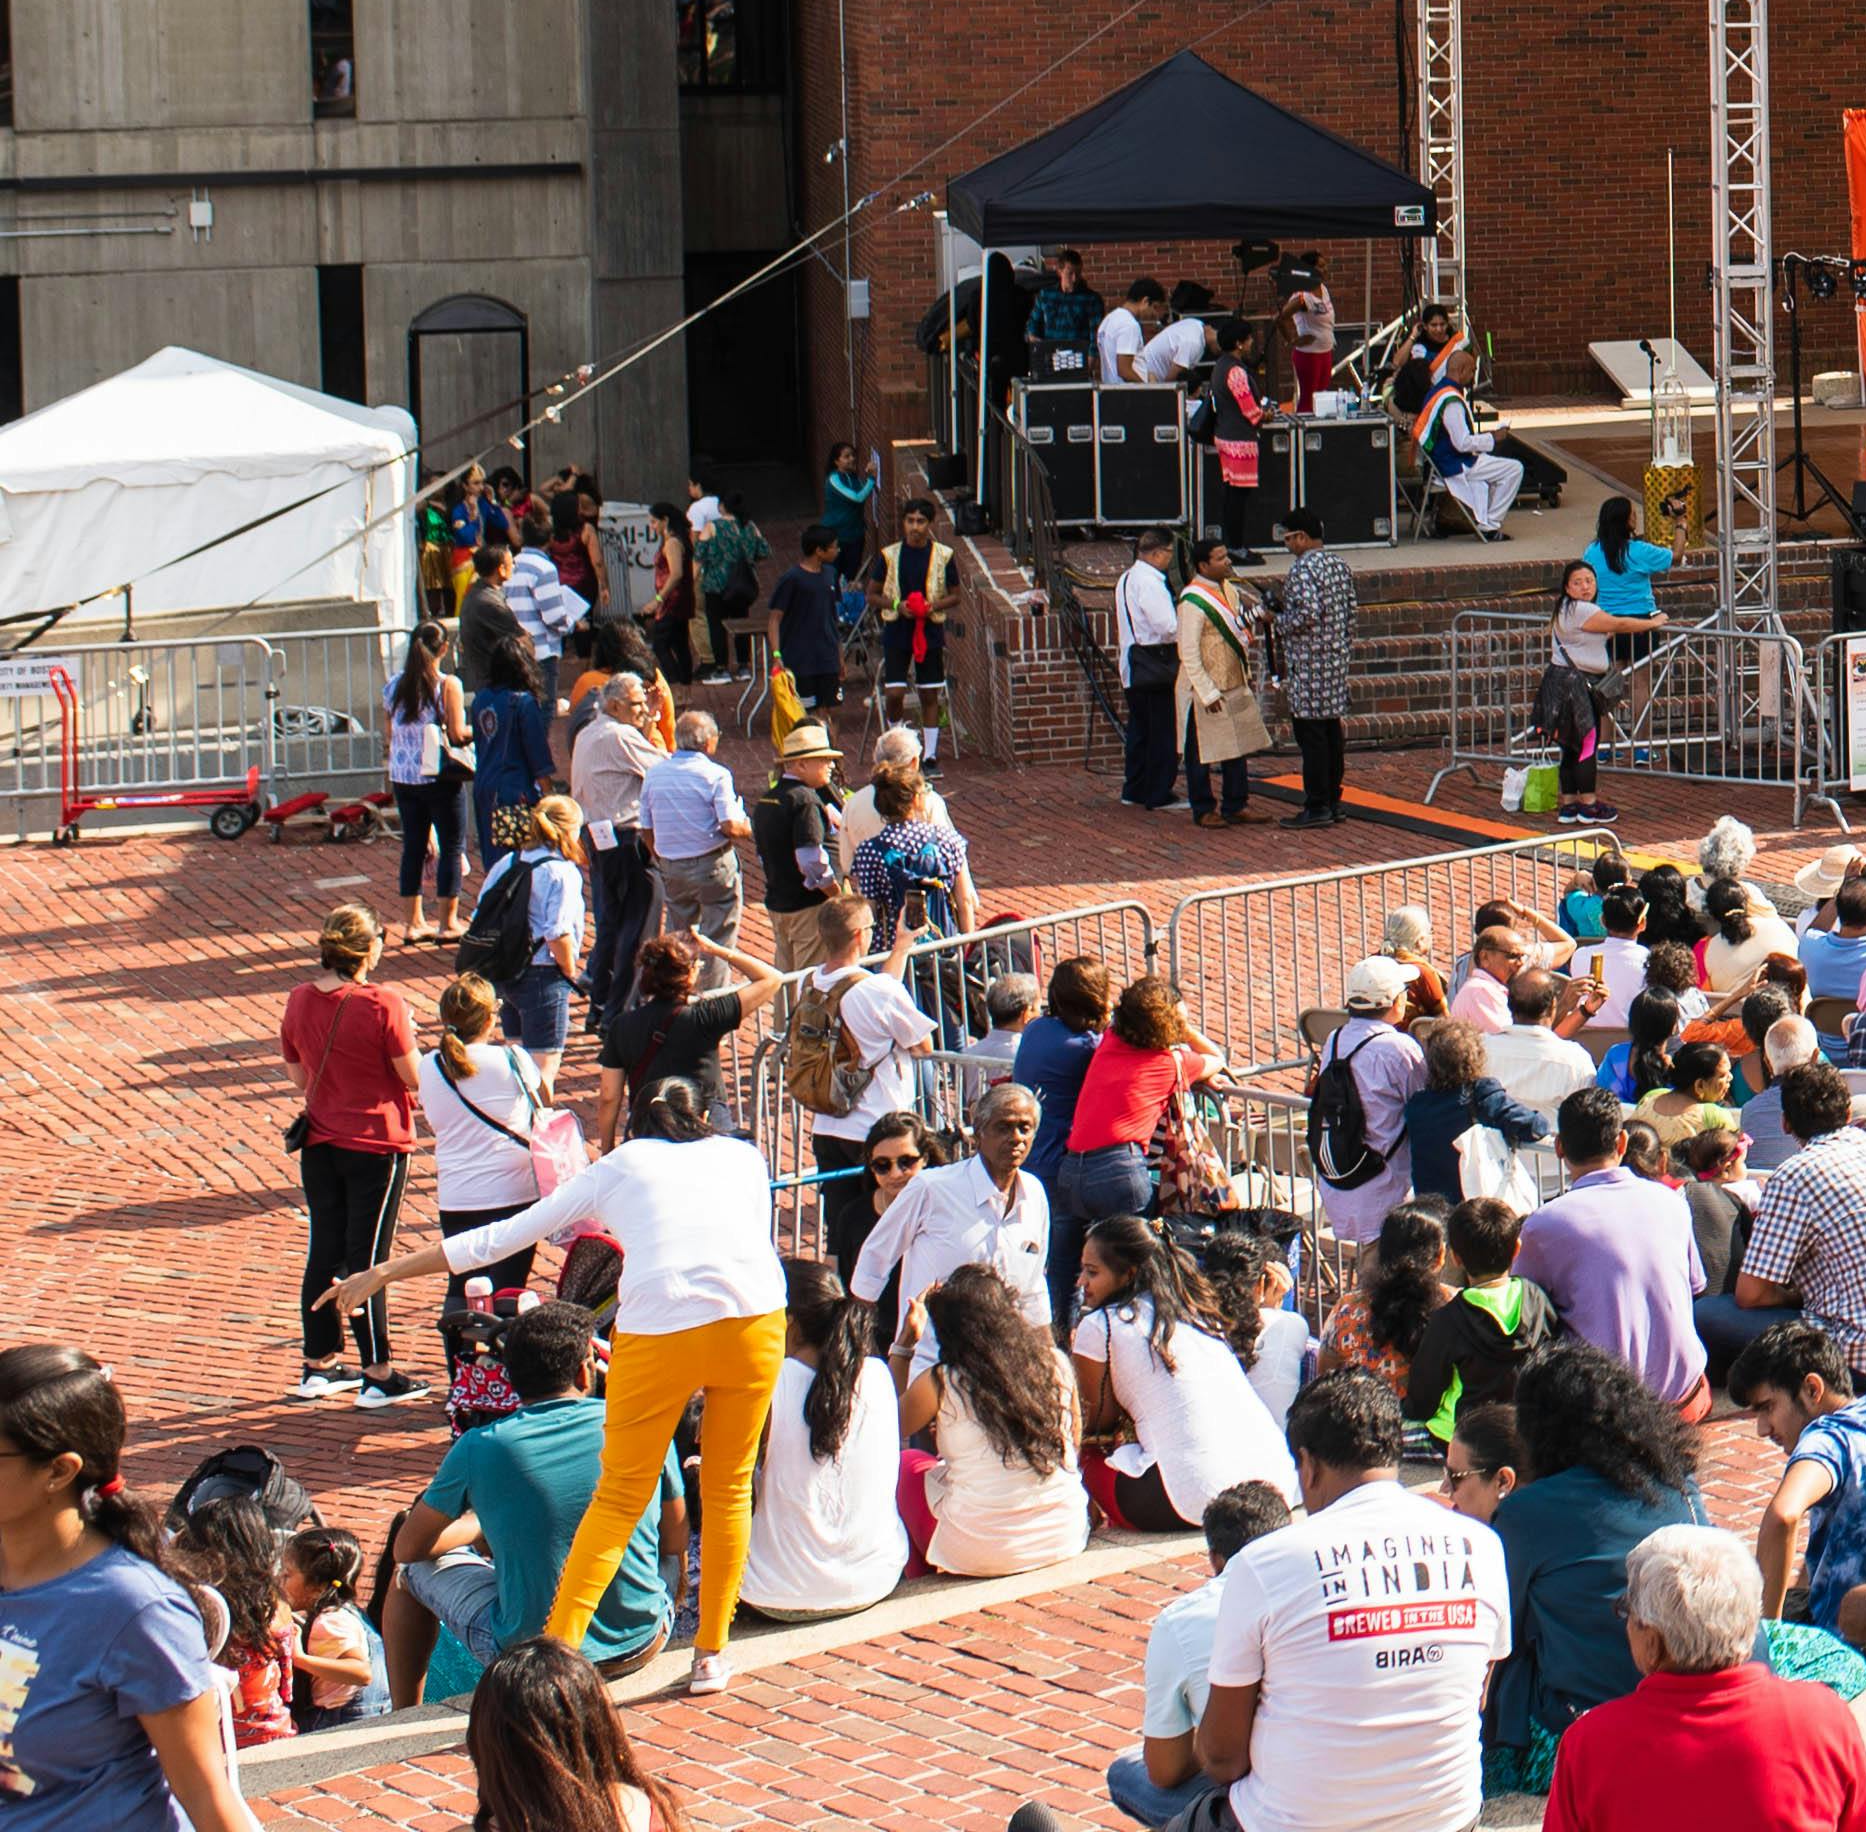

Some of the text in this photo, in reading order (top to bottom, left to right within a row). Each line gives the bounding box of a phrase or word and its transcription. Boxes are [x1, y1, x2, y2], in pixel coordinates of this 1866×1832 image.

[1314, 1536, 1473, 1571] IMAGINED
[1323, 1561, 1475, 1597] IN INDIA
[1333, 1604, 1474, 1636] BREWED IN THE USA
[1376, 1646, 1426, 1669] BIRA
